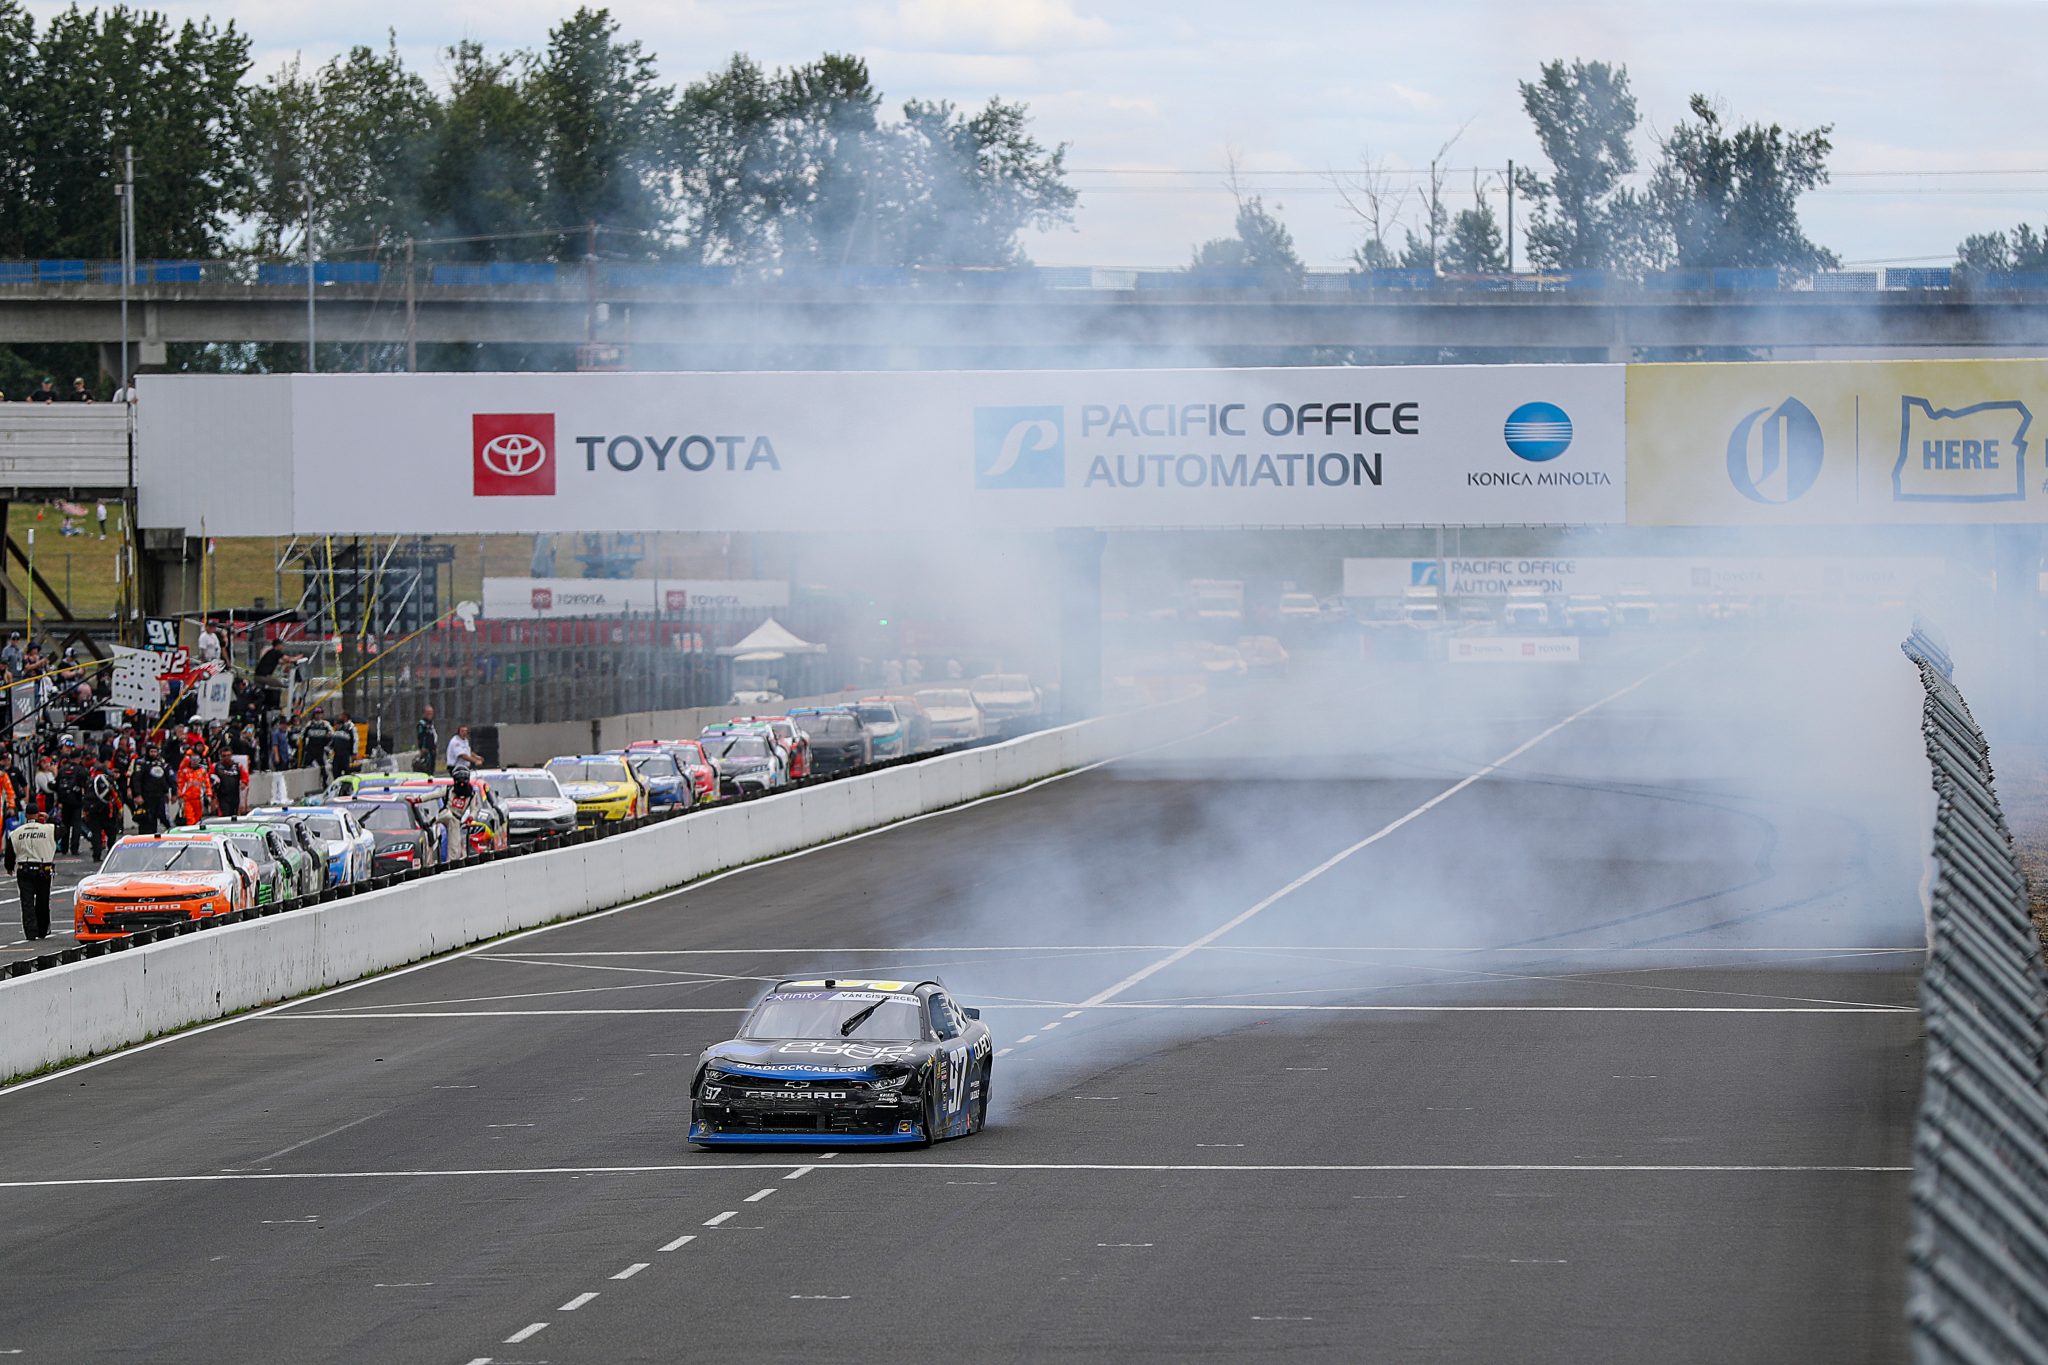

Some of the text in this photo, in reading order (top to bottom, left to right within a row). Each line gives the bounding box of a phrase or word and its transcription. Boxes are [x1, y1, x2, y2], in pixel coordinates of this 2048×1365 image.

[1081, 401, 1419, 438] PACIFIC OFFICE
[576, 435, 781, 471] TOYOTA
[1923, 439, 1999, 470] HERE
[1083, 452, 1383, 488] AUTOMATION
[1467, 471, 1612, 487] KONICA MINOLTA
[1452, 560, 1577, 575] PACIFIC OFFICE
[557, 594, 606, 605] TOYOTA
[146, 620, 177, 645] 91
[161, 649, 188, 674] 92
[19, 832, 47, 840] OFFICIAL
[774, 992, 823, 1001] xfinity
[736, 1063, 867, 1073] QUADLOCKCASE.COM
[948, 1045, 968, 1114] 97
[705, 1086, 722, 1100] 97
